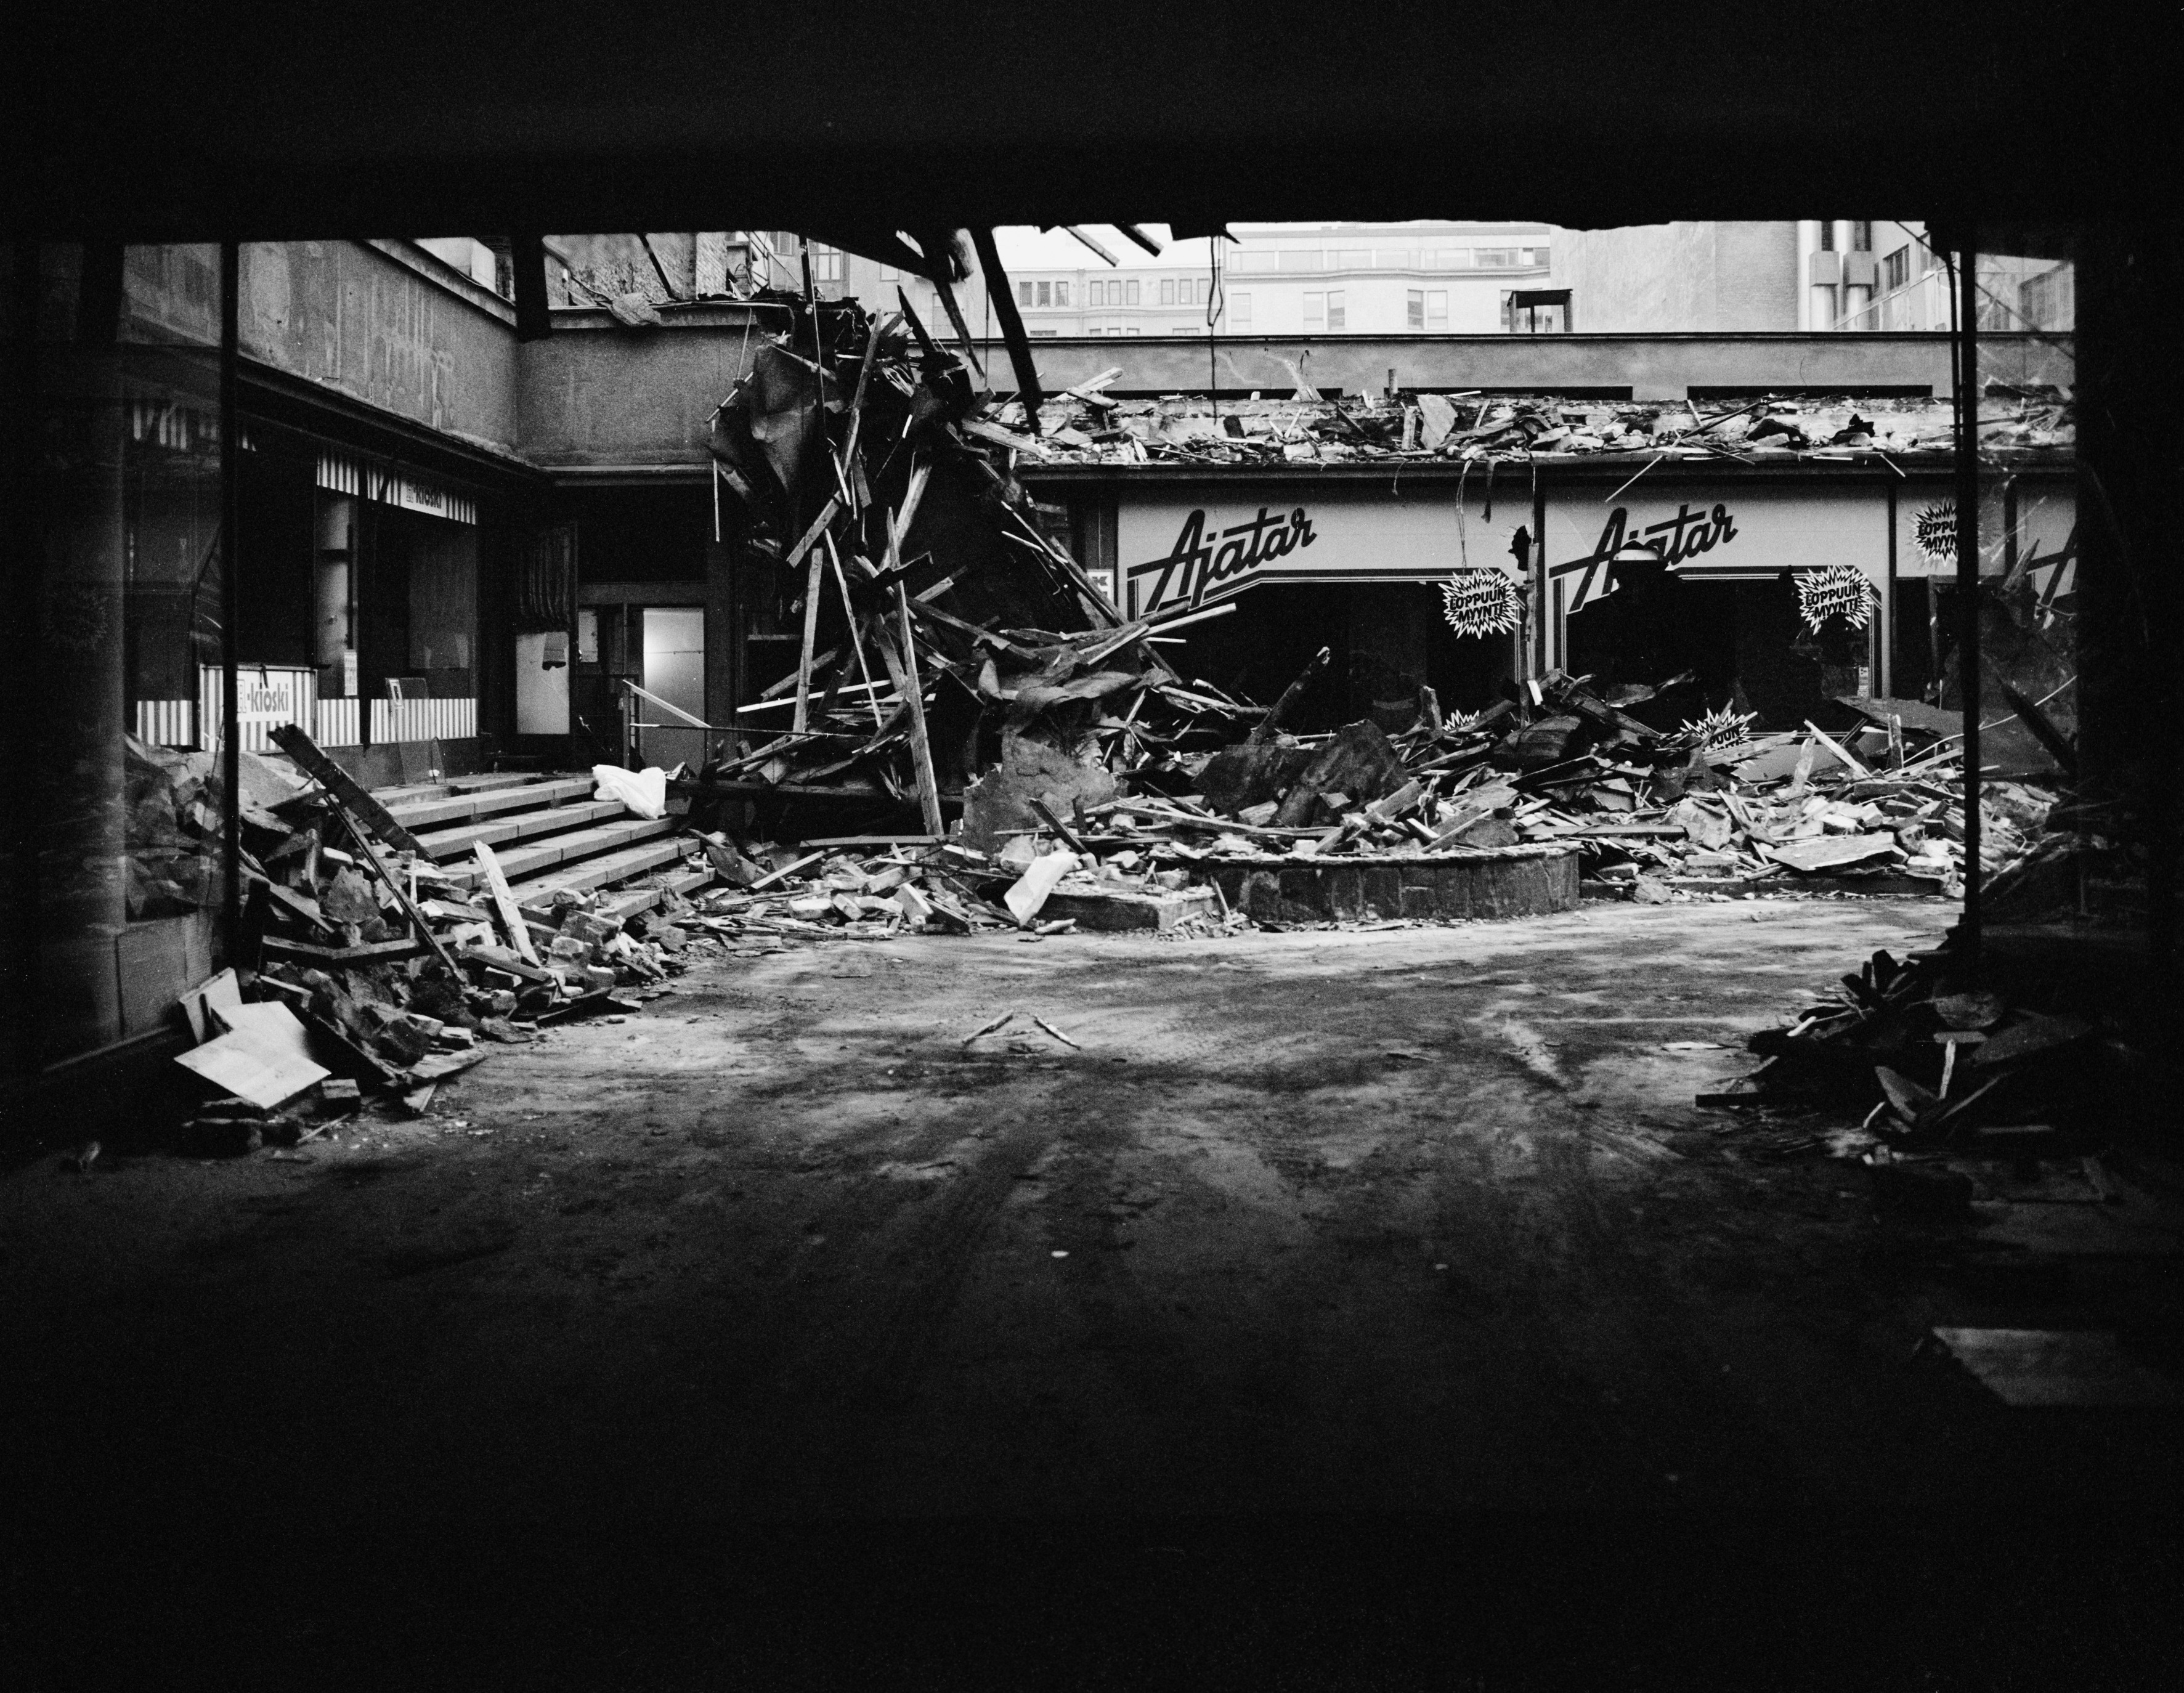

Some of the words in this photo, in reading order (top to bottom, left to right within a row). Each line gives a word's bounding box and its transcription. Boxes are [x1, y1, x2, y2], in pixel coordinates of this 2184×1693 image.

[1918, 520, 1958, 536] LOPPU
[1925, 534, 1958, 549] MYYN
[1127, 506, 1317, 614] Ajatar
[1450, 587, 1506, 611] LOPPUUN
[1805, 583, 1860, 606] LOPPUUN
[1458, 602, 1503, 623] MYYNTI
[1814, 597, 1858, 619] MYYNTI
[1709, 727, 1740, 748] PUUN
